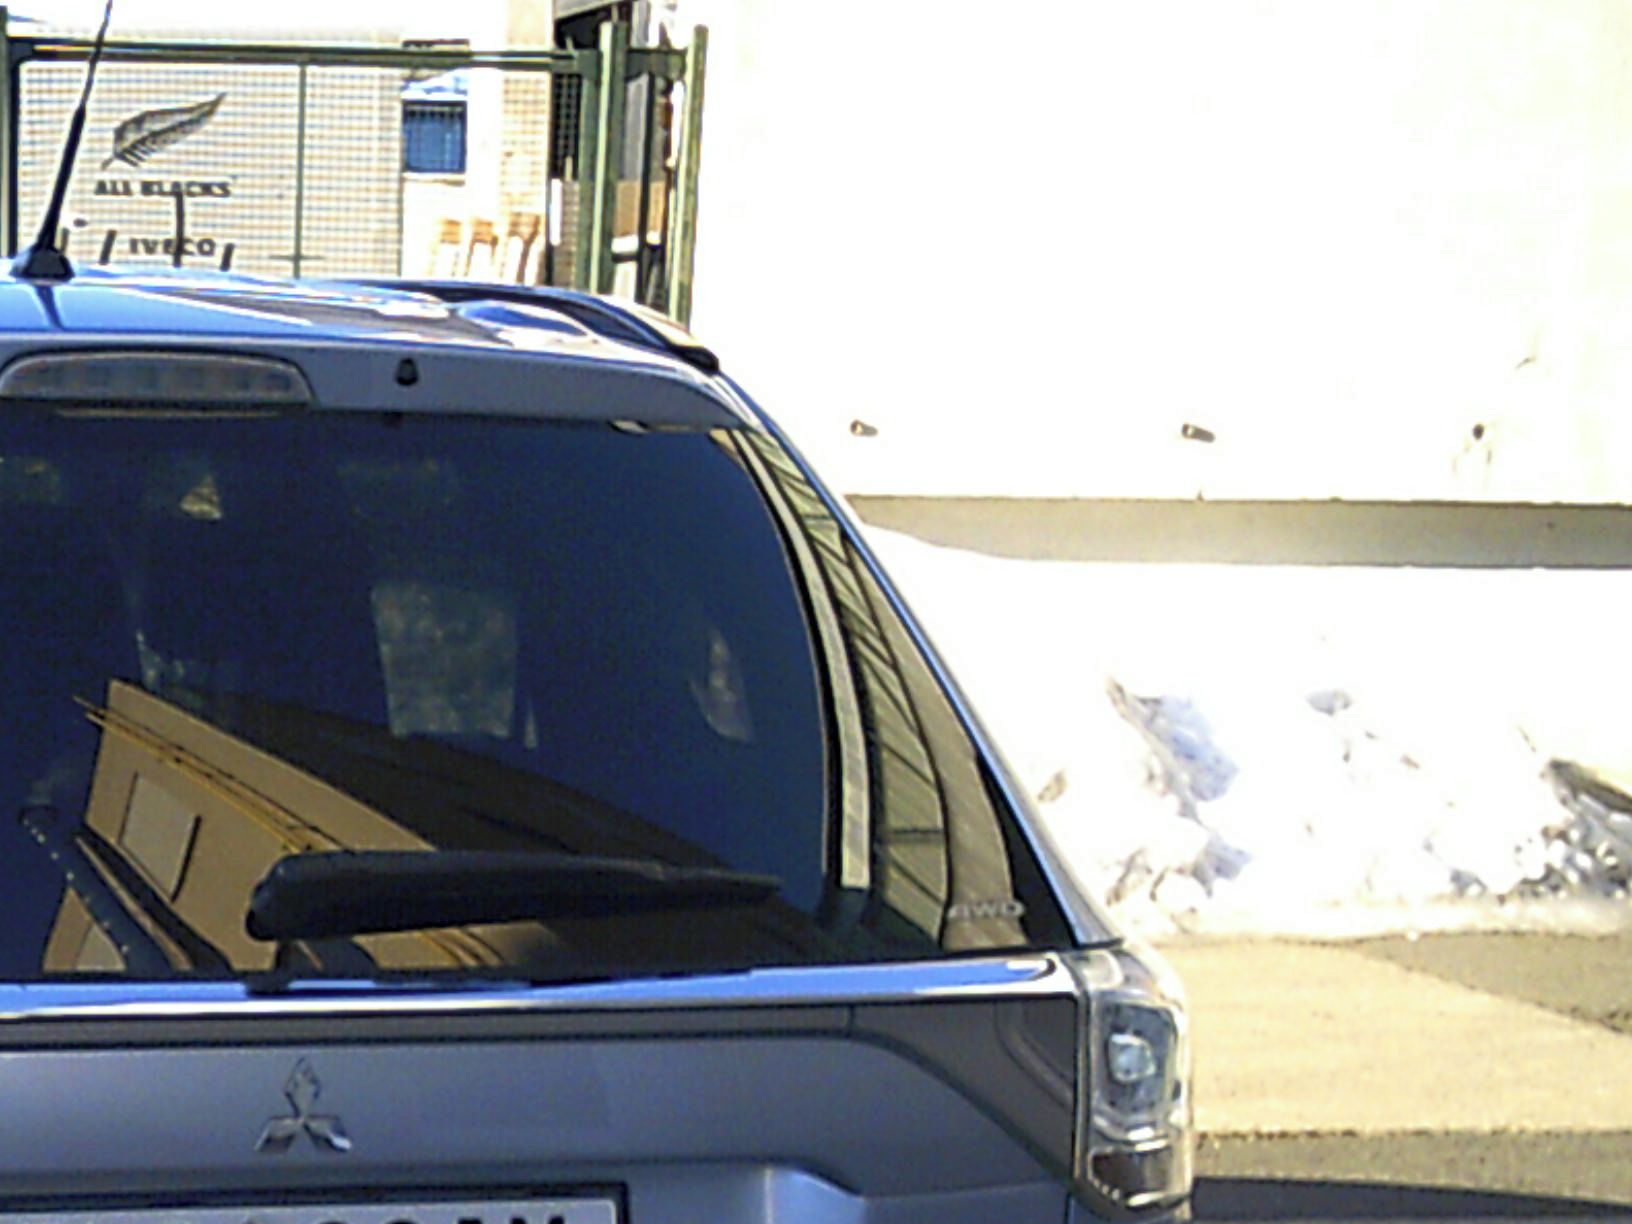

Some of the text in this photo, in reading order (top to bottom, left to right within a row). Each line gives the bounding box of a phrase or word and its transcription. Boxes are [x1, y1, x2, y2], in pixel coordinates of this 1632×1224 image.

[94, 179, 232, 198] ALL BLACKS
[129, 237, 217, 257] IVECO
